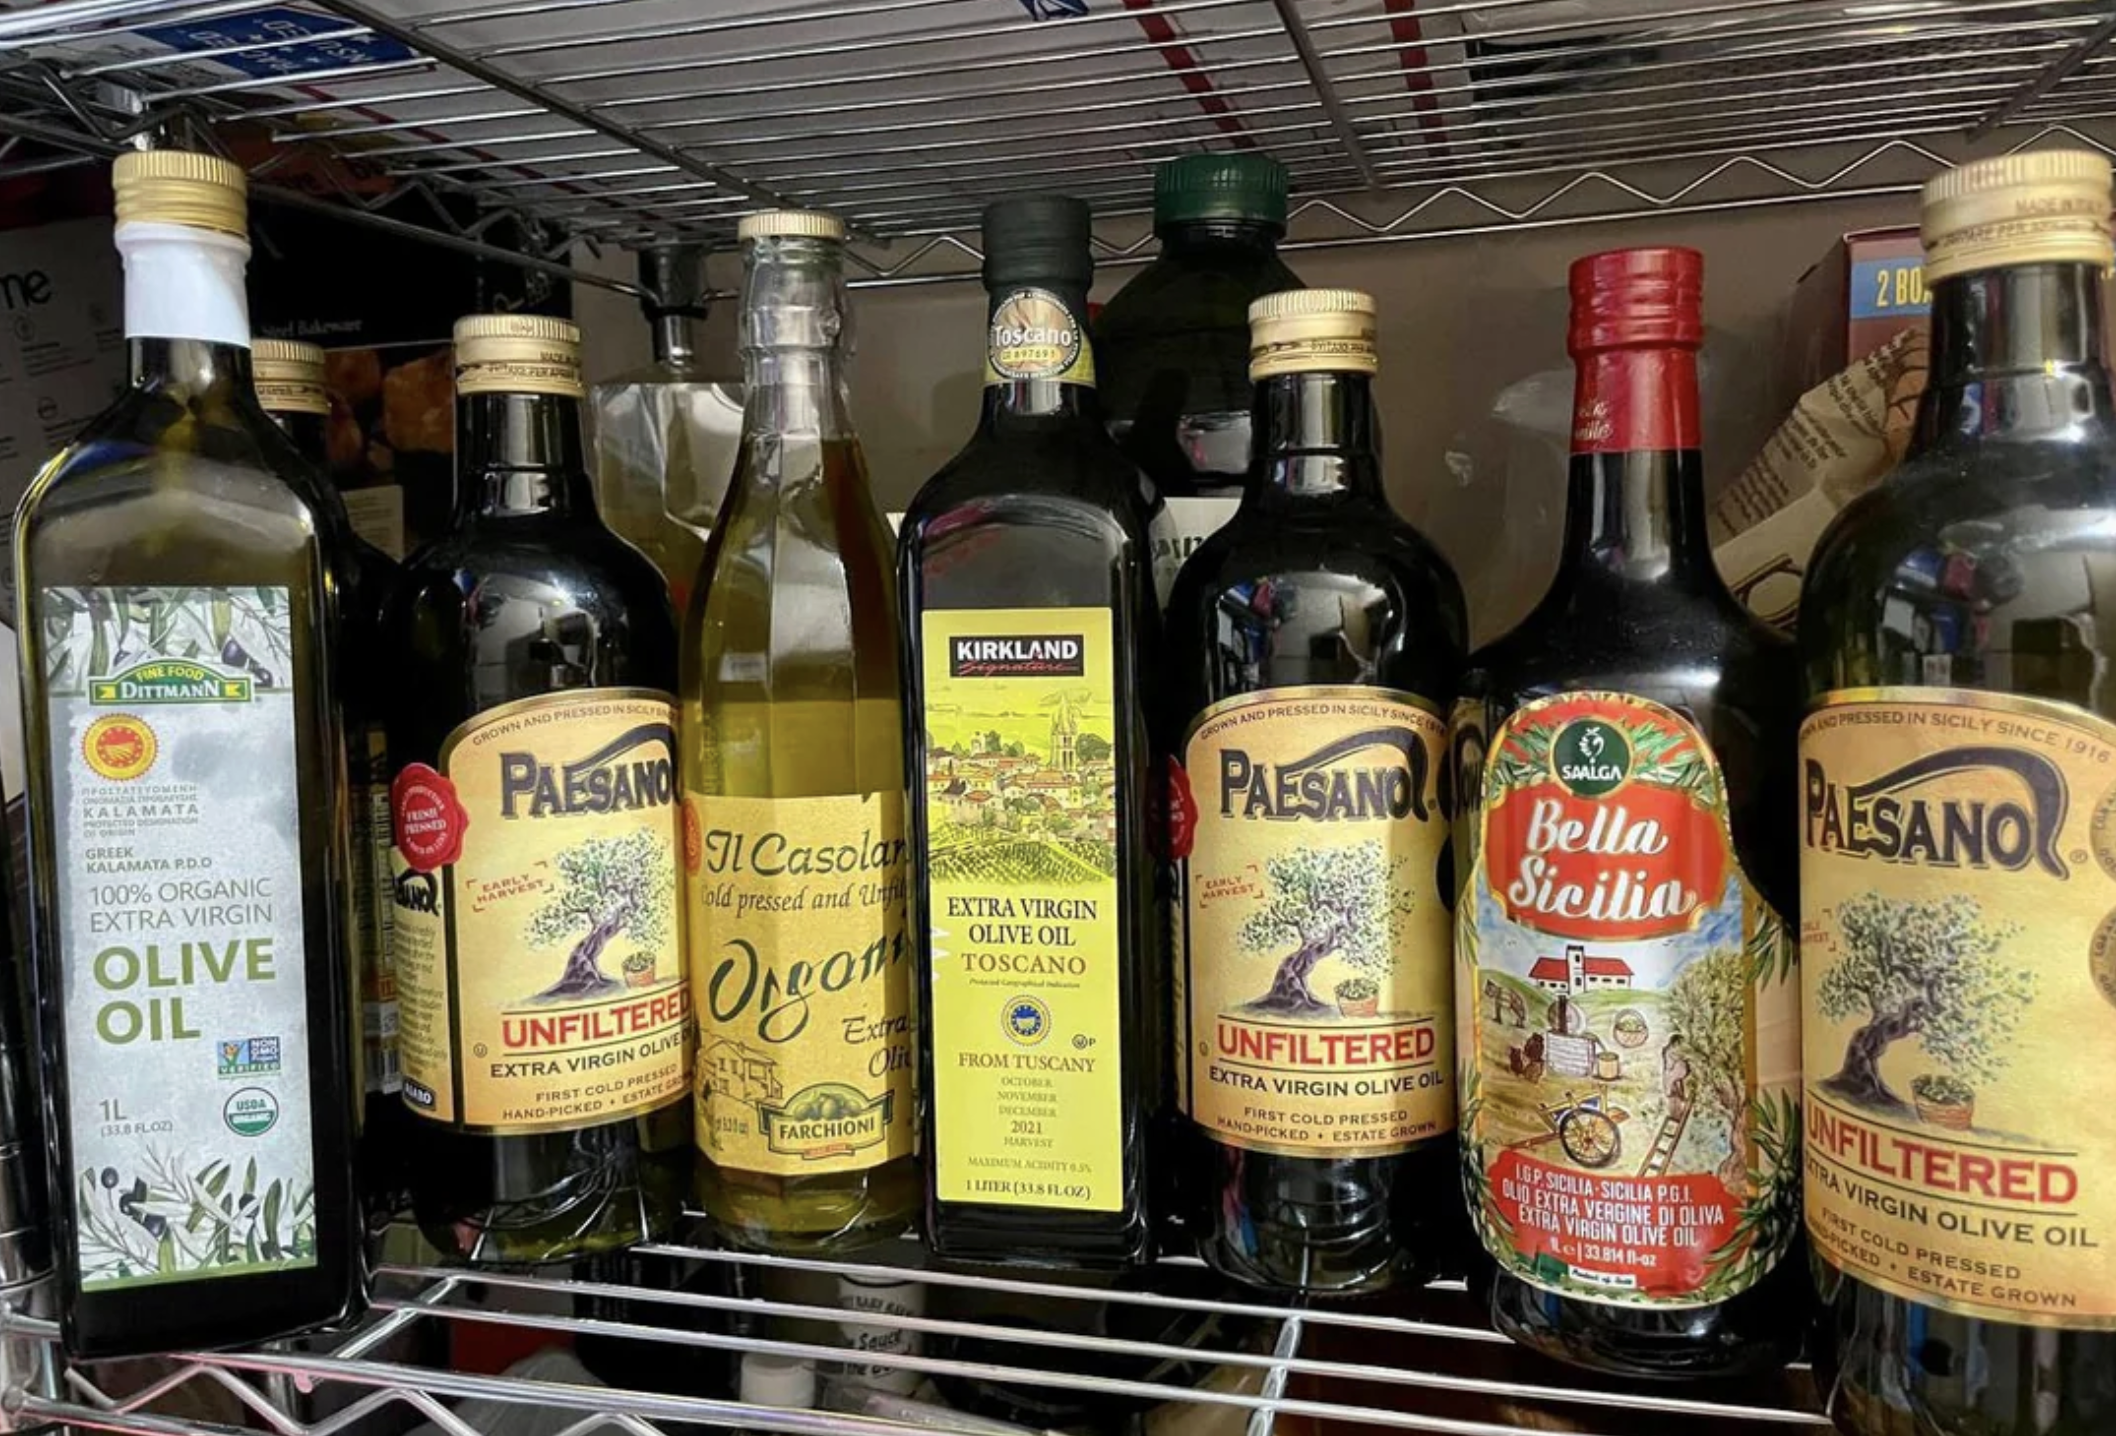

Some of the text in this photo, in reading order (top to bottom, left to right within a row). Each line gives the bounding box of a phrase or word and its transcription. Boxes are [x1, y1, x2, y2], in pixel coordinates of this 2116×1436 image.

[1877, 269, 1889, 307] 2
[994, 325, 1072, 347] Toscano
[956, 640, 1078, 661] KIRKLAND
[136, 666, 205, 682] FINE FOOD
[958, 660, 1080, 679] Signature
[472, 704, 656, 747] GROWN AND PRESSED IN SICILY
[1200, 718, 1238, 740] GROWN
[1240, 710, 1265, 724] AND
[1267, 703, 1330, 719] PRESSED
[1332, 703, 1346, 715] IN
[1349, 705, 1389, 719] SICILY
[1390, 708, 1425, 727] SINCE
[1838, 711, 1903, 727] PRESSED
[1907, 711, 1926, 725] IN
[1931, 713, 1992, 732] SICILY
[1998, 721, 2064, 746] SINCE
[2065, 736, 2111, 764] 1916
[499, 733, 678, 819] PAESANO
[1220, 737, 1426, 822] PAESANO
[83, 804, 199, 819] KALAMATA
[1806, 752, 2058, 875] PAESANO
[1525, 797, 1669, 855] Bella
[85, 847, 133, 860] GREEK
[86, 858, 169, 873] KALAMATA
[90, 877, 273, 906] 100% ORGANIC
[476, 879, 545, 904] HARVEST
[482, 874, 530, 892] EARLY
[1201, 883, 1255, 899] HARVEST
[1205, 876, 1242, 889] EARLY
[1507, 855, 1697, 922] Sicilia
[736, 884, 809, 919] pressed
[811, 882, 854, 909] and
[947, 896, 1097, 920] EXTRA VIRGIN
[91, 903, 273, 933] EXTRA VIRGIN
[968, 924, 1076, 947] OLIVE OIL
[92, 938, 276, 991] OLIVE
[961, 953, 1087, 975] TOSCANO
[96, 997, 201, 1045] OIL
[501, 987, 690, 1049] UNFILTERED
[842, 1014, 908, 1044] Extra
[490, 1060, 561, 1079] EXTRA
[567, 1049, 635, 1073] VIRGIN
[639, 1034, 681, 1058] OLIVE
[1217, 1024, 1435, 1066] UNFILTERED
[958, 1052, 1096, 1073] FROM TUSCANY
[535, 1064, 678, 1103] FIRST COLD PRESSED
[1001, 1076, 1053, 1088] OCTOBER
[1209, 1065, 1444, 1096] EXTRA VIRGIN OLIVE OIL
[99, 1099, 127, 1121] 1L
[236, 1100, 266, 1111] USDA
[502, 1082, 664, 1120] HAND-PICKED ESTATE
[997, 1091, 1057, 1102] NOVEMBER
[999, 1105, 1057, 1117] DECEMBER
[1244, 1106, 1408, 1126] FIRST COLD PRESSED
[779, 1117, 874, 1139] FARCHIONI
[1011, 1120, 1042, 1134] 2021
[1217, 1117, 1436, 1142] HAND-PICKED ESTATE GROWN
[1004, 1136, 1053, 1148] HARVEST
[1807, 1103, 2078, 1205] UNFILTERED
[968, 1156, 1022, 1169] MAXIMUM
[1024, 1159, 1068, 1173] ACIDITY
[966, 1179, 971, 1191] 1
[975, 1179, 1011, 1193] LITER
[1013, 1180, 1045, 1196] (33.8
[1515, 1163, 1693, 1203] I.G.P. SICILIA SICILIA P.G.I.
[1502, 1178, 1725, 1226] OLIO EXTRA VERGINE DI OLIVA
[1845, 1179, 2098, 1248] VIRGIN OLIVE OIL
[1519, 1203, 1700, 1247] EXTRA VIRGIN OLIVE OIL
[1585, 1244, 1624, 1264] 33.814
[1822, 1206, 2021, 1280] FIRST COLD PRESSED
[1907, 1266, 2077, 1307] ESTATE GROWN
